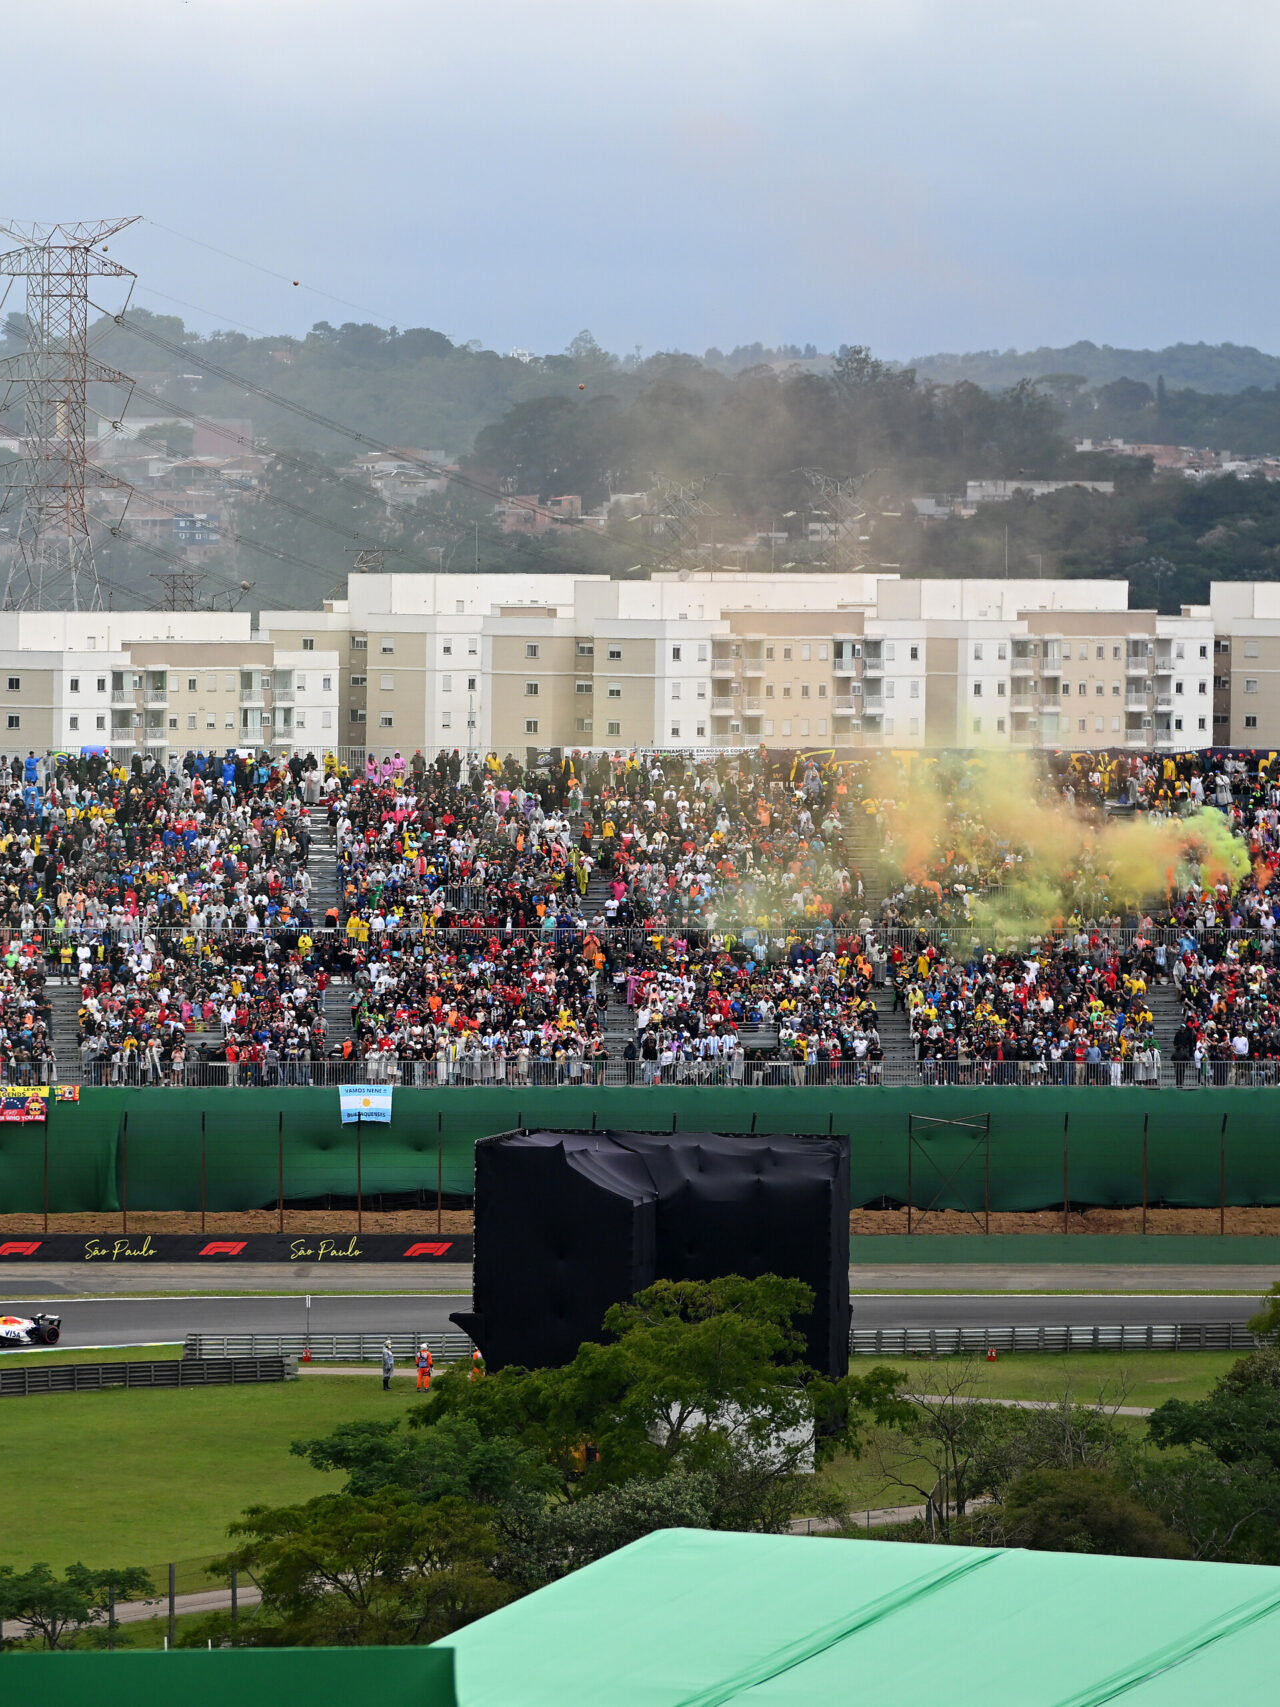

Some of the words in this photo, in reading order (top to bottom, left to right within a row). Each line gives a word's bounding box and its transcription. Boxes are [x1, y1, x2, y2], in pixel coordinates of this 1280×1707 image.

[85, 1239, 110, 1260] São
[112, 1236, 158, 1260] Paulo
[290, 1240, 314, 1259] São
[318, 1236, 362, 1260] Paulo
[5, 1330, 20, 1338] VISA
